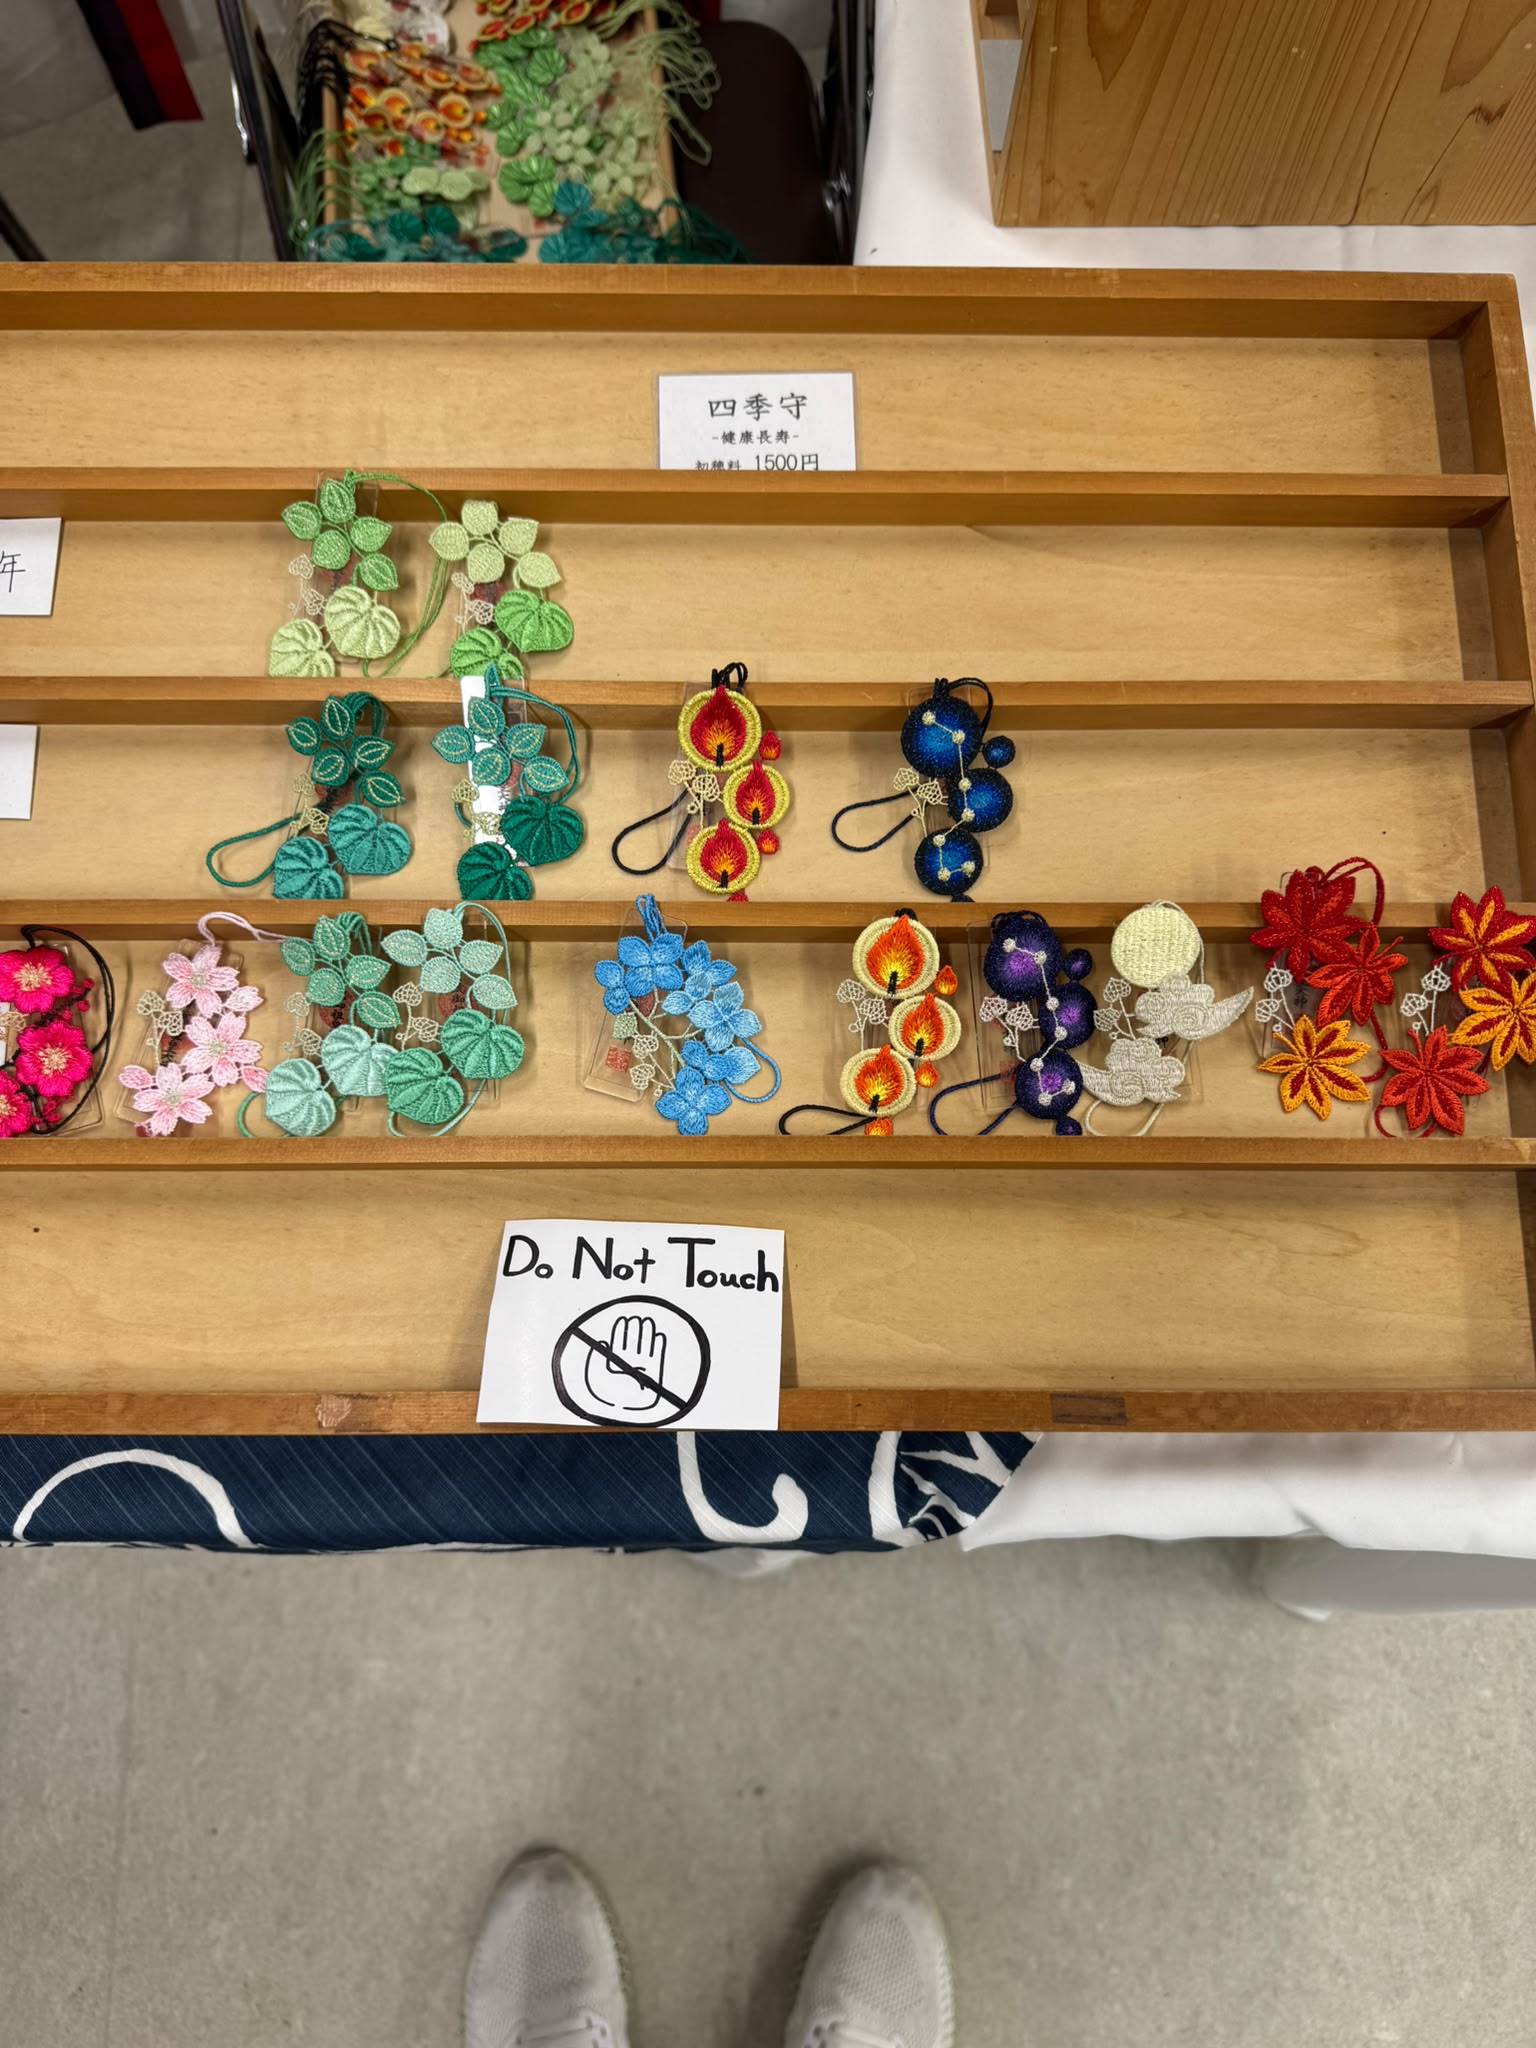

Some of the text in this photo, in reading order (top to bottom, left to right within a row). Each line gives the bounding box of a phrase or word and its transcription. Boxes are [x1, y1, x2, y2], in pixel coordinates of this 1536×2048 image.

[708, 392, 808, 421] 四季守
[755, 453, 820, 471] 1500円
[502, 1234, 780, 1293] Do Not Touch
